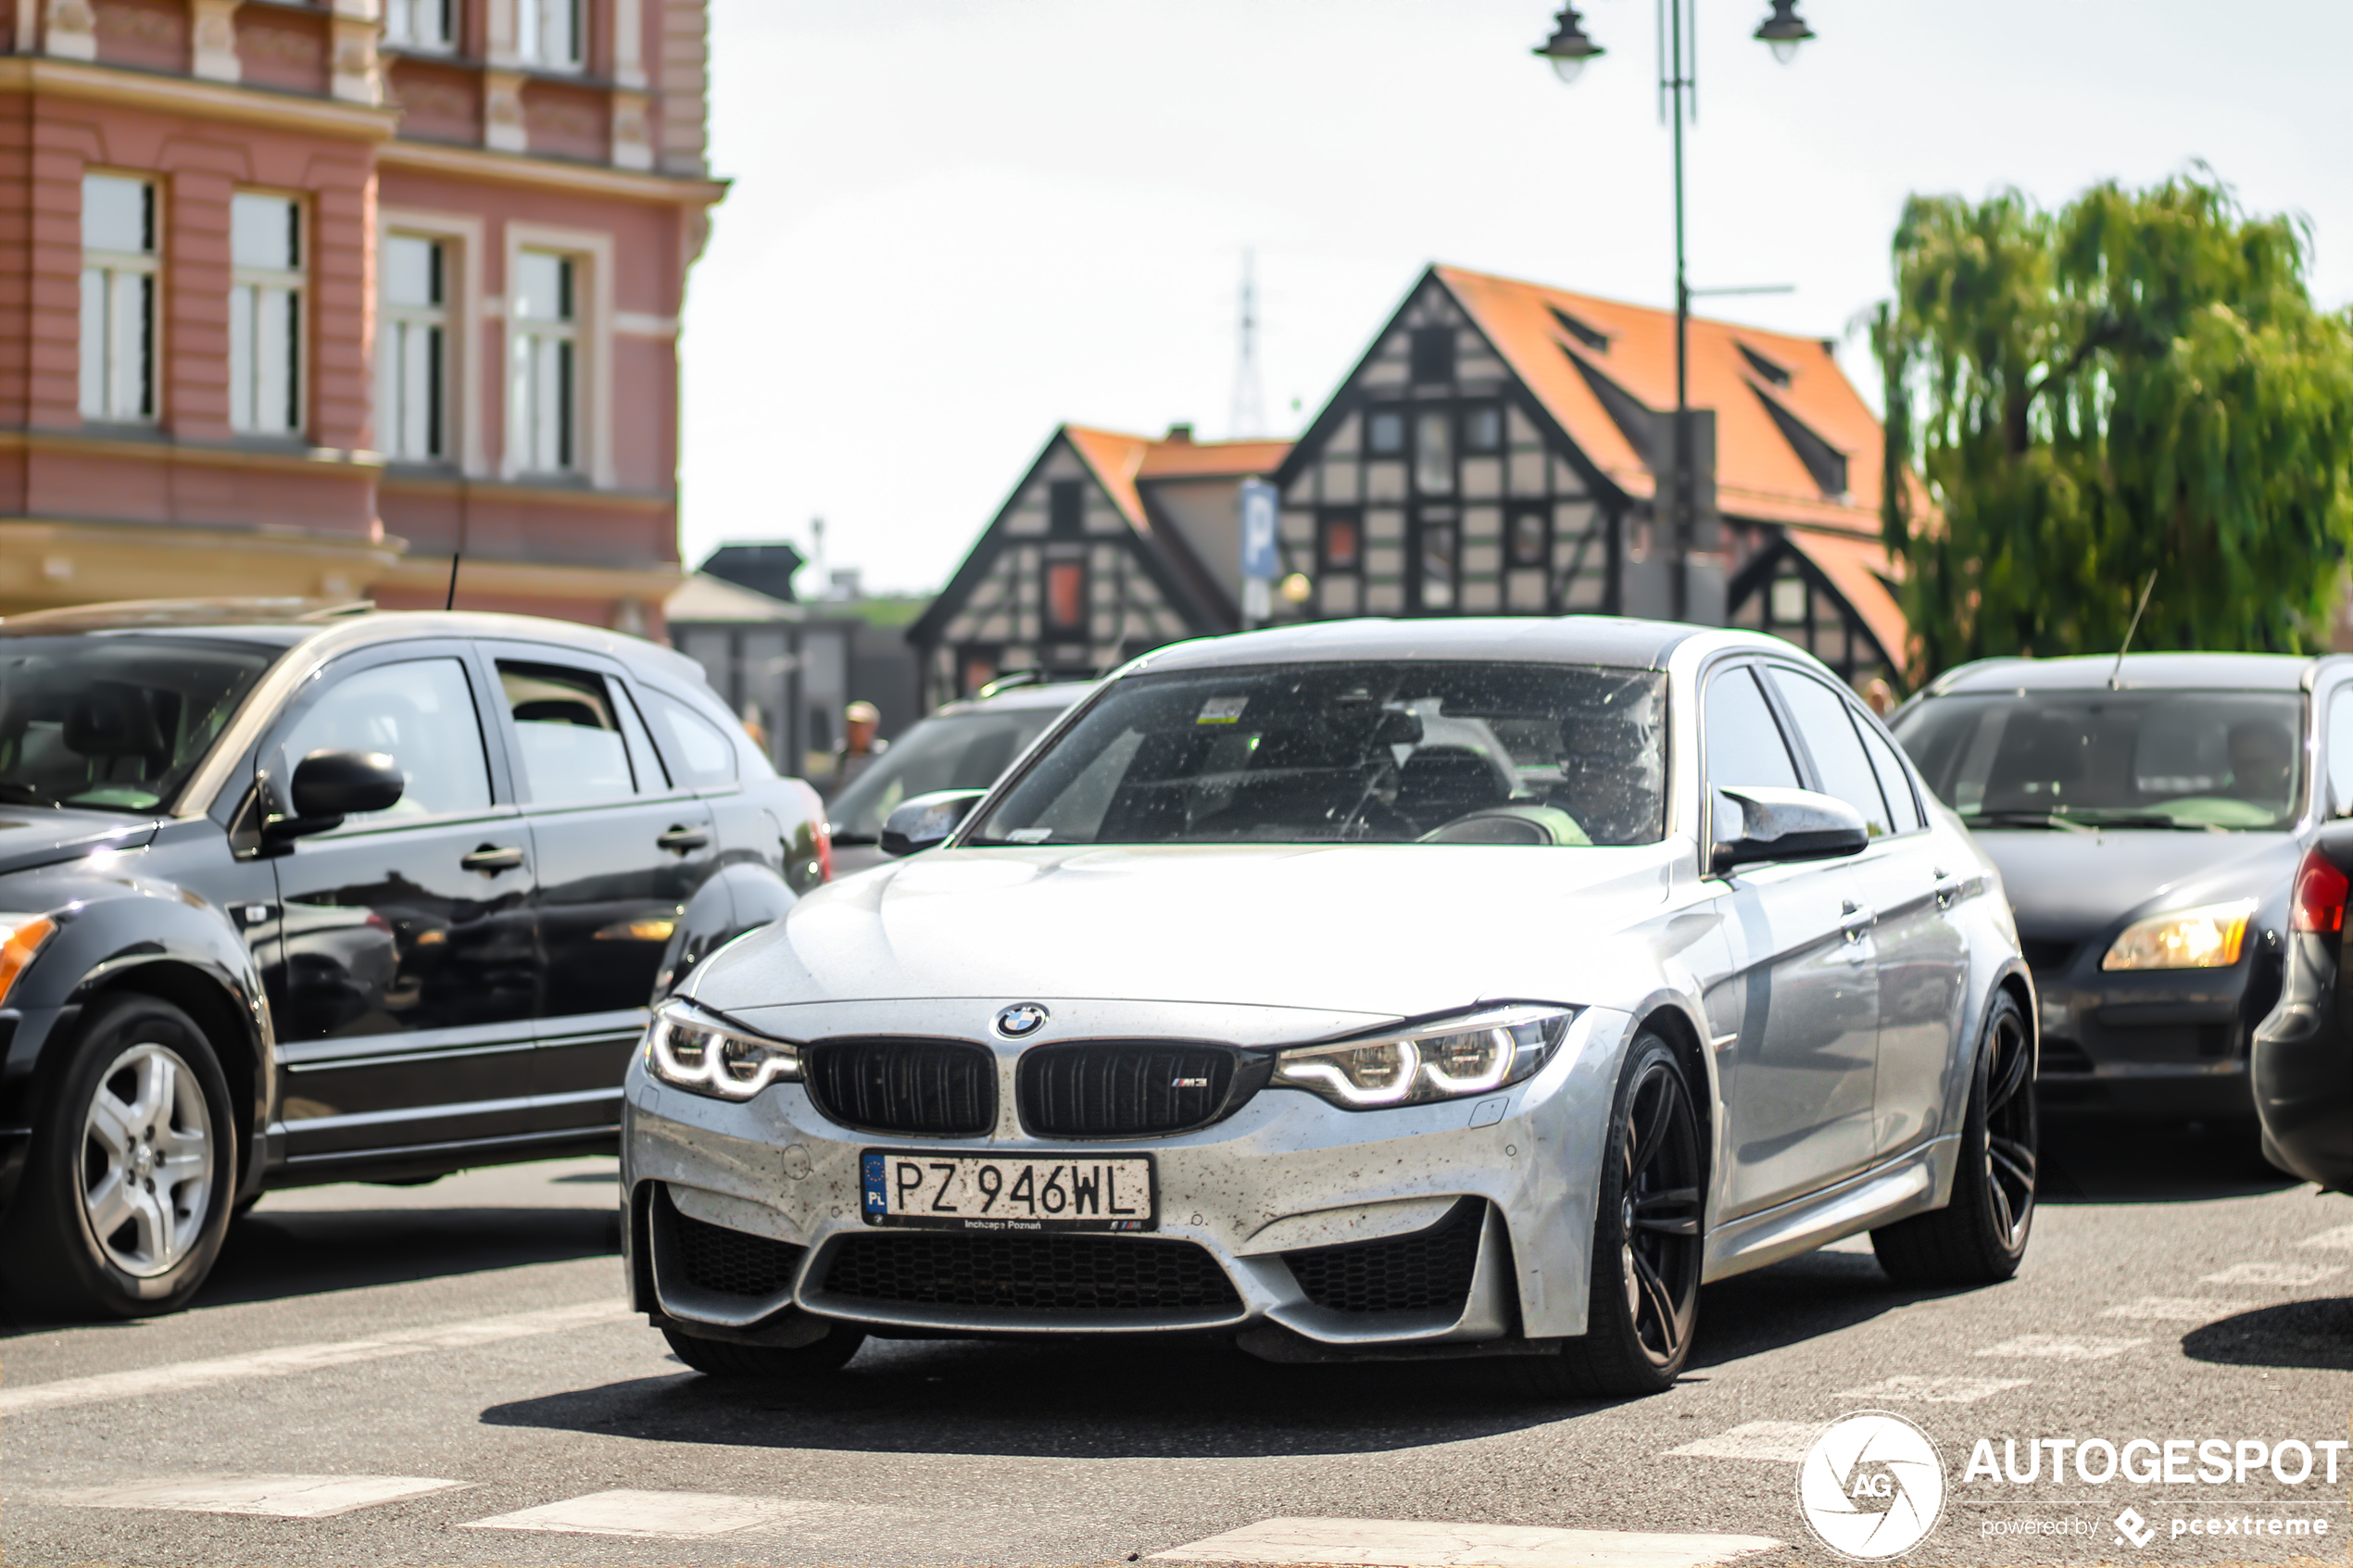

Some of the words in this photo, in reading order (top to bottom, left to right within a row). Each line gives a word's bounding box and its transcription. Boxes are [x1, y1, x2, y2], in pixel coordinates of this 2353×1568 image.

[1246, 495, 1273, 566] P
[1176, 1078, 1208, 1086] M3
[896, 1162, 958, 1211] PZ
[978, 1165, 1137, 1214] 946WL
[868, 1191, 886, 1206] PL
[1008, 1220, 1041, 1230] Poznań
